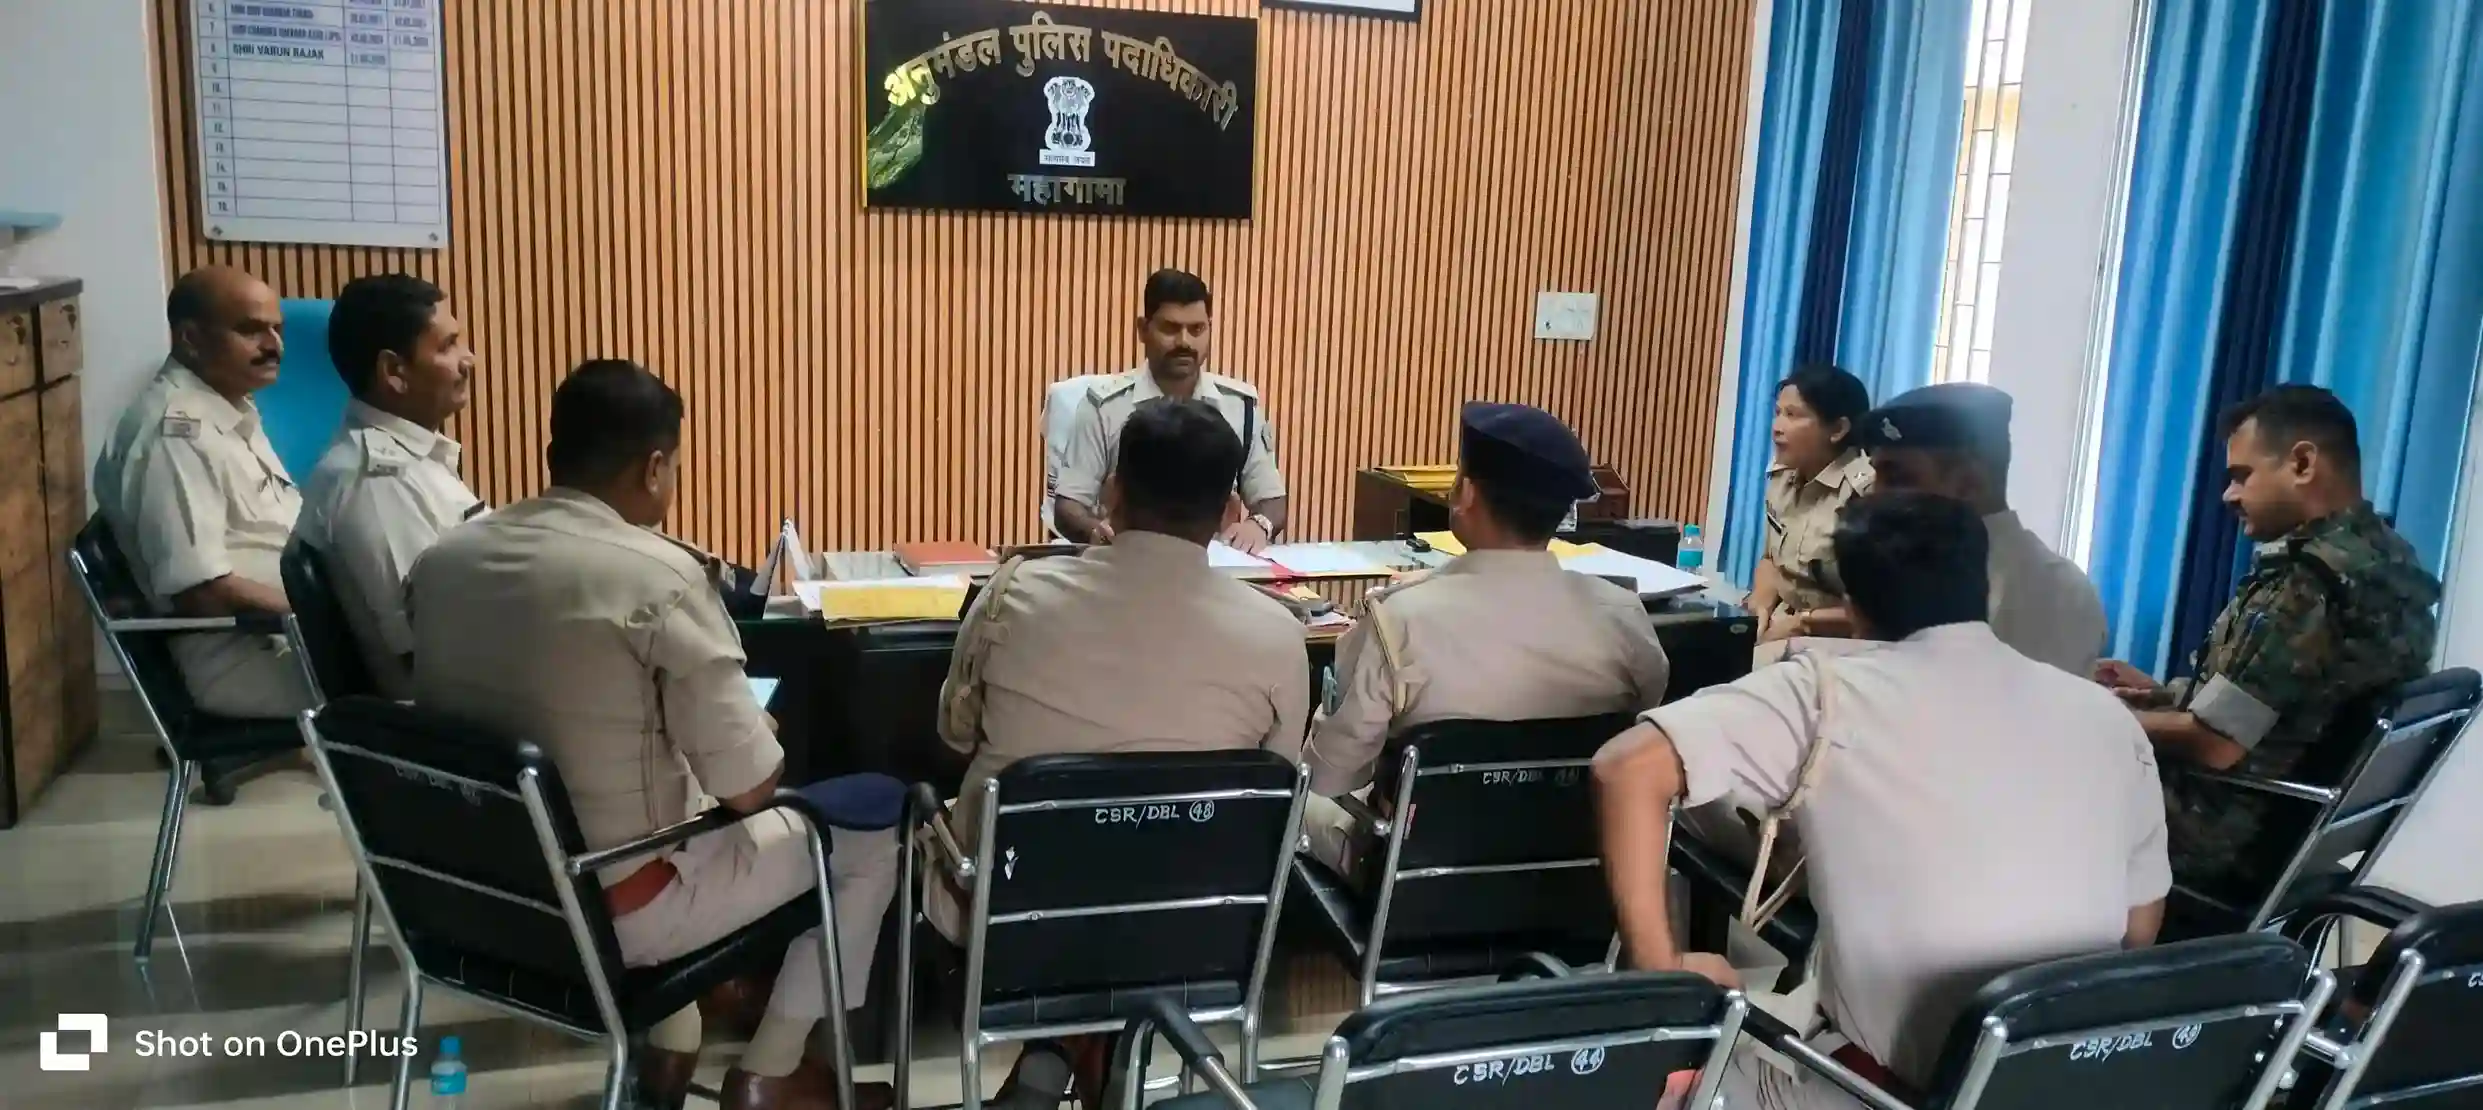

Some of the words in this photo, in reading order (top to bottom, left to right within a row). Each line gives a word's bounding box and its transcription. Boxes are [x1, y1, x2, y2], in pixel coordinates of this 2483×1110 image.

[885, 29, 1001, 105] अनुमंडल
[1009, 10, 1092, 77] पुलिस
[1102, 29, 1239, 131] पदाधिकारी
[1007, 173, 1127, 206] महागामा
[1095, 804, 1180, 829] CSR/DBL
[1454, 1055, 1554, 1088] CSR/DBL
